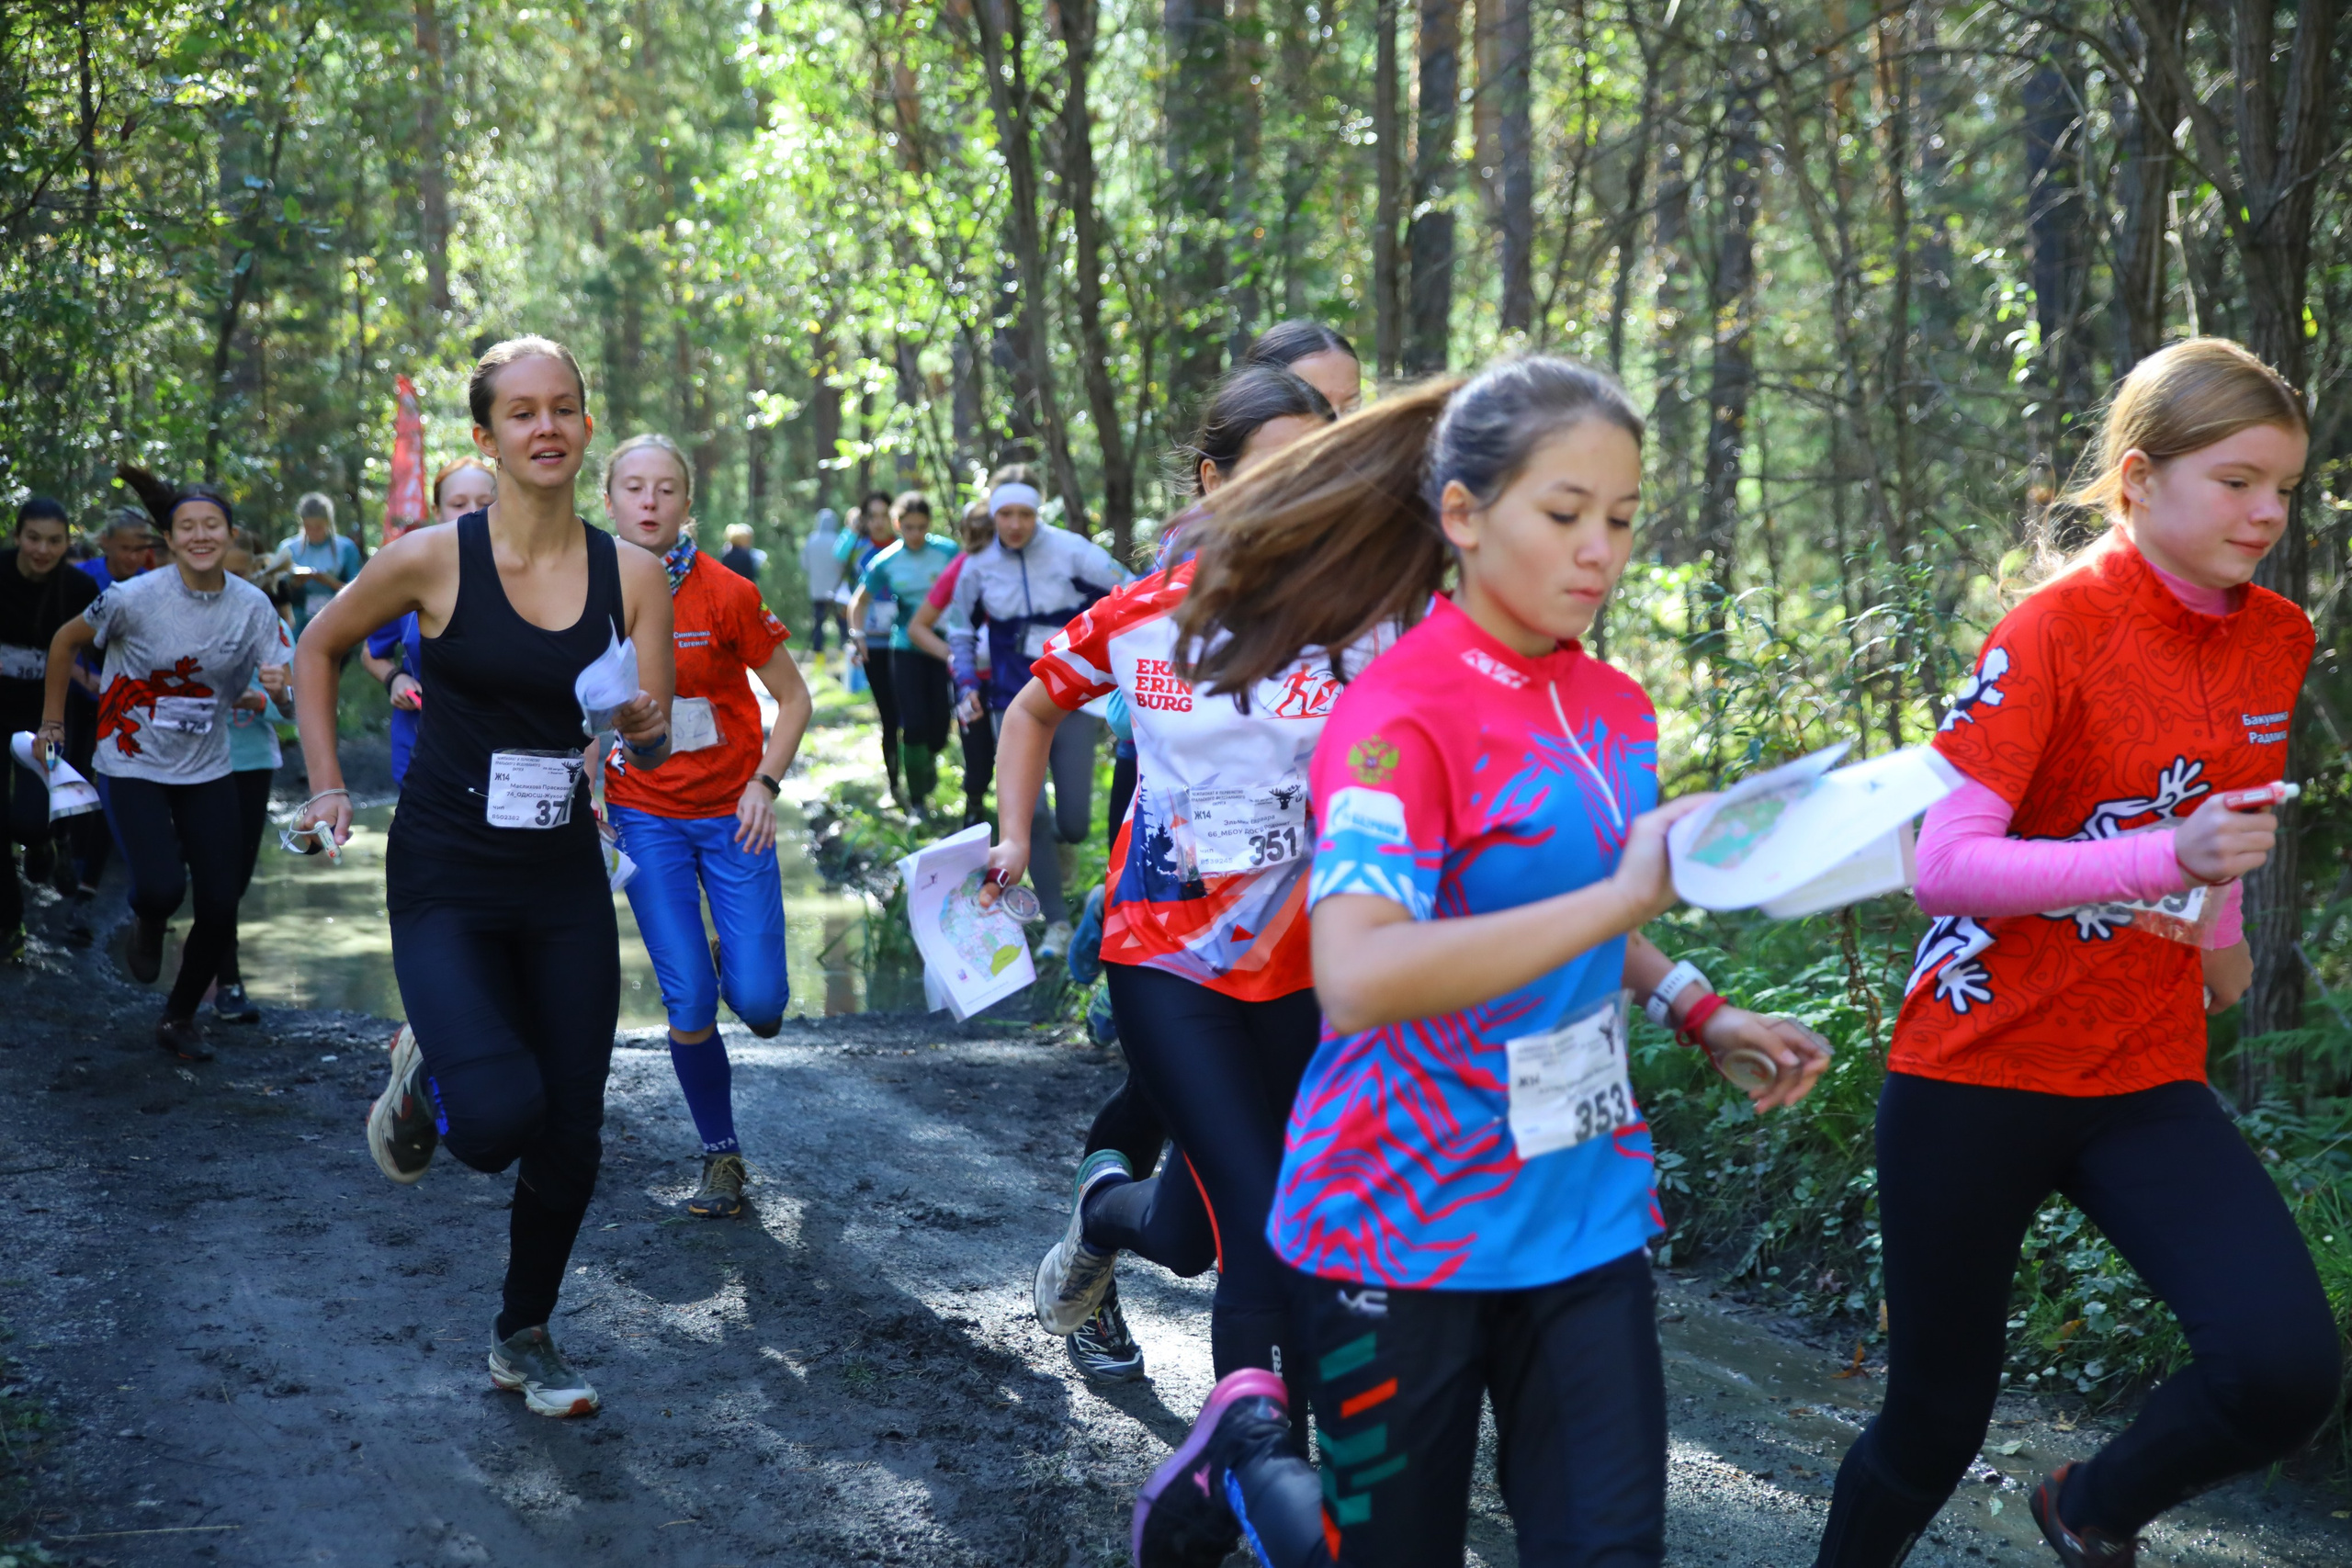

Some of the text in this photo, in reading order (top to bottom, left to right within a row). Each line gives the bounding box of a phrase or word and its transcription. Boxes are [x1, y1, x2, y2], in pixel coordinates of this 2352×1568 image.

[1135, 675, 1193, 695] ERIN
[1135, 693, 1193, 712] BURG
[494, 773, 510, 781] Ж14
[1194, 810, 1212, 820] Ж14
[1249, 827, 1297, 865] 351
[1576, 1082, 1628, 1142] 353
